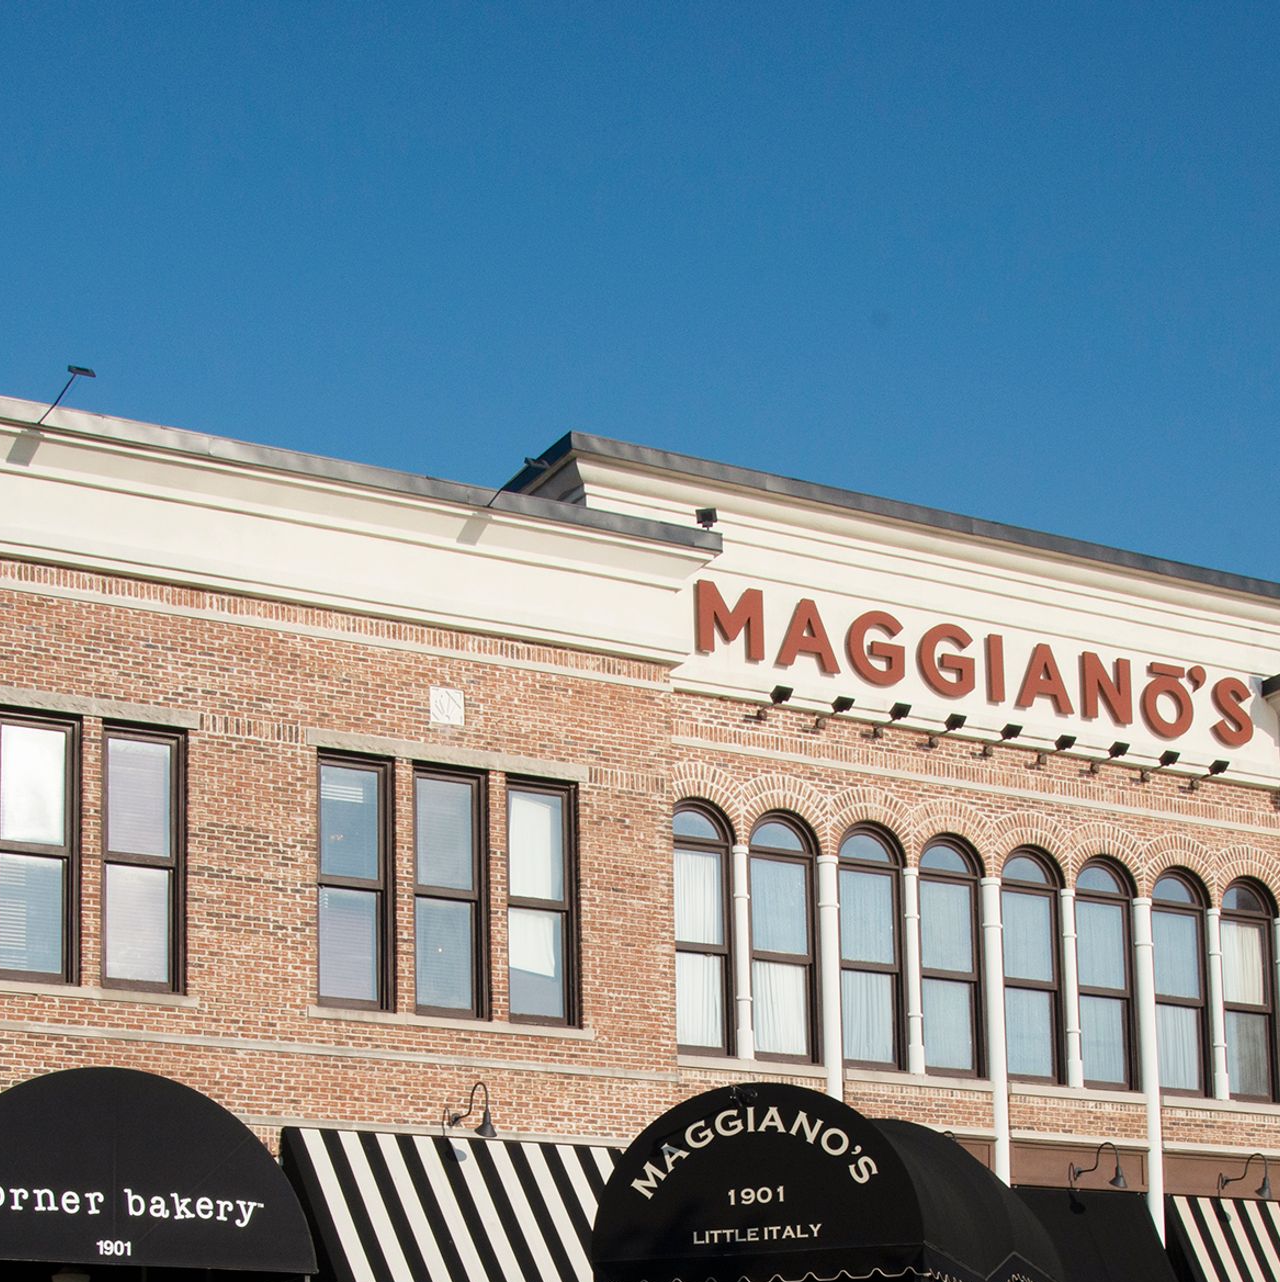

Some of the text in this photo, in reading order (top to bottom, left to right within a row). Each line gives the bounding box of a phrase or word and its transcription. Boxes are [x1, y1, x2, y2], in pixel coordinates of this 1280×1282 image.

[693, 578, 1255, 747] MAGGIANO'S
[630, 1106, 879, 1200] MAGGIANO'S
[727, 1185, 785, 1206] 1901
[692, 1223, 823, 1245] LITTLE ITALY
[96, 1240, 132, 1257] 1901
